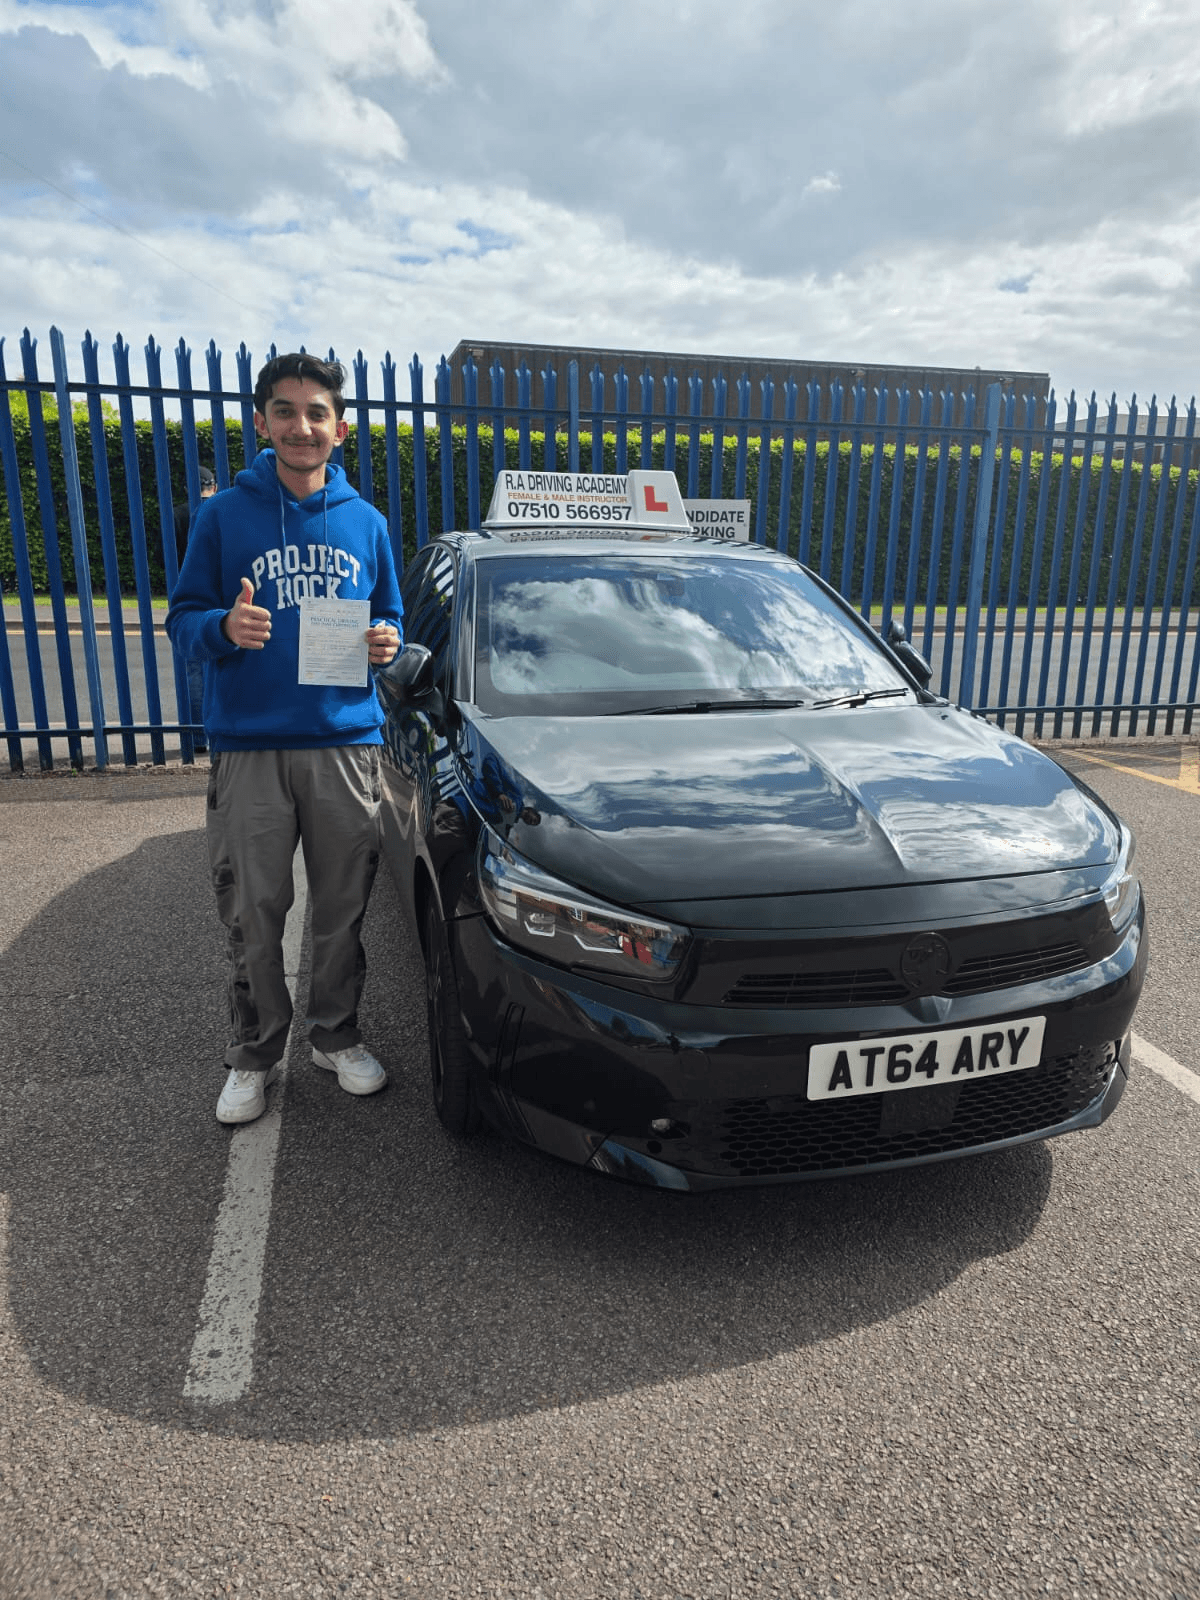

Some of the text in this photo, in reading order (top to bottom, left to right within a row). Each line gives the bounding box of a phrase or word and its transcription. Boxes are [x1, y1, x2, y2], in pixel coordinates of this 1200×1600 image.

[505, 473, 627, 494] R.A DRIVING ACADEMY
[507, 492, 628, 503] FEMALE & MALE INSTRUCTOR
[643, 485, 669, 512] L
[507, 501, 632, 521] 07510 566957
[685, 510, 745, 523] NDIDATE
[251, 544, 361, 591] PROJECT
[276, 574, 342, 610] ROCK
[827, 1026, 1030, 1092] AT64 ARY
